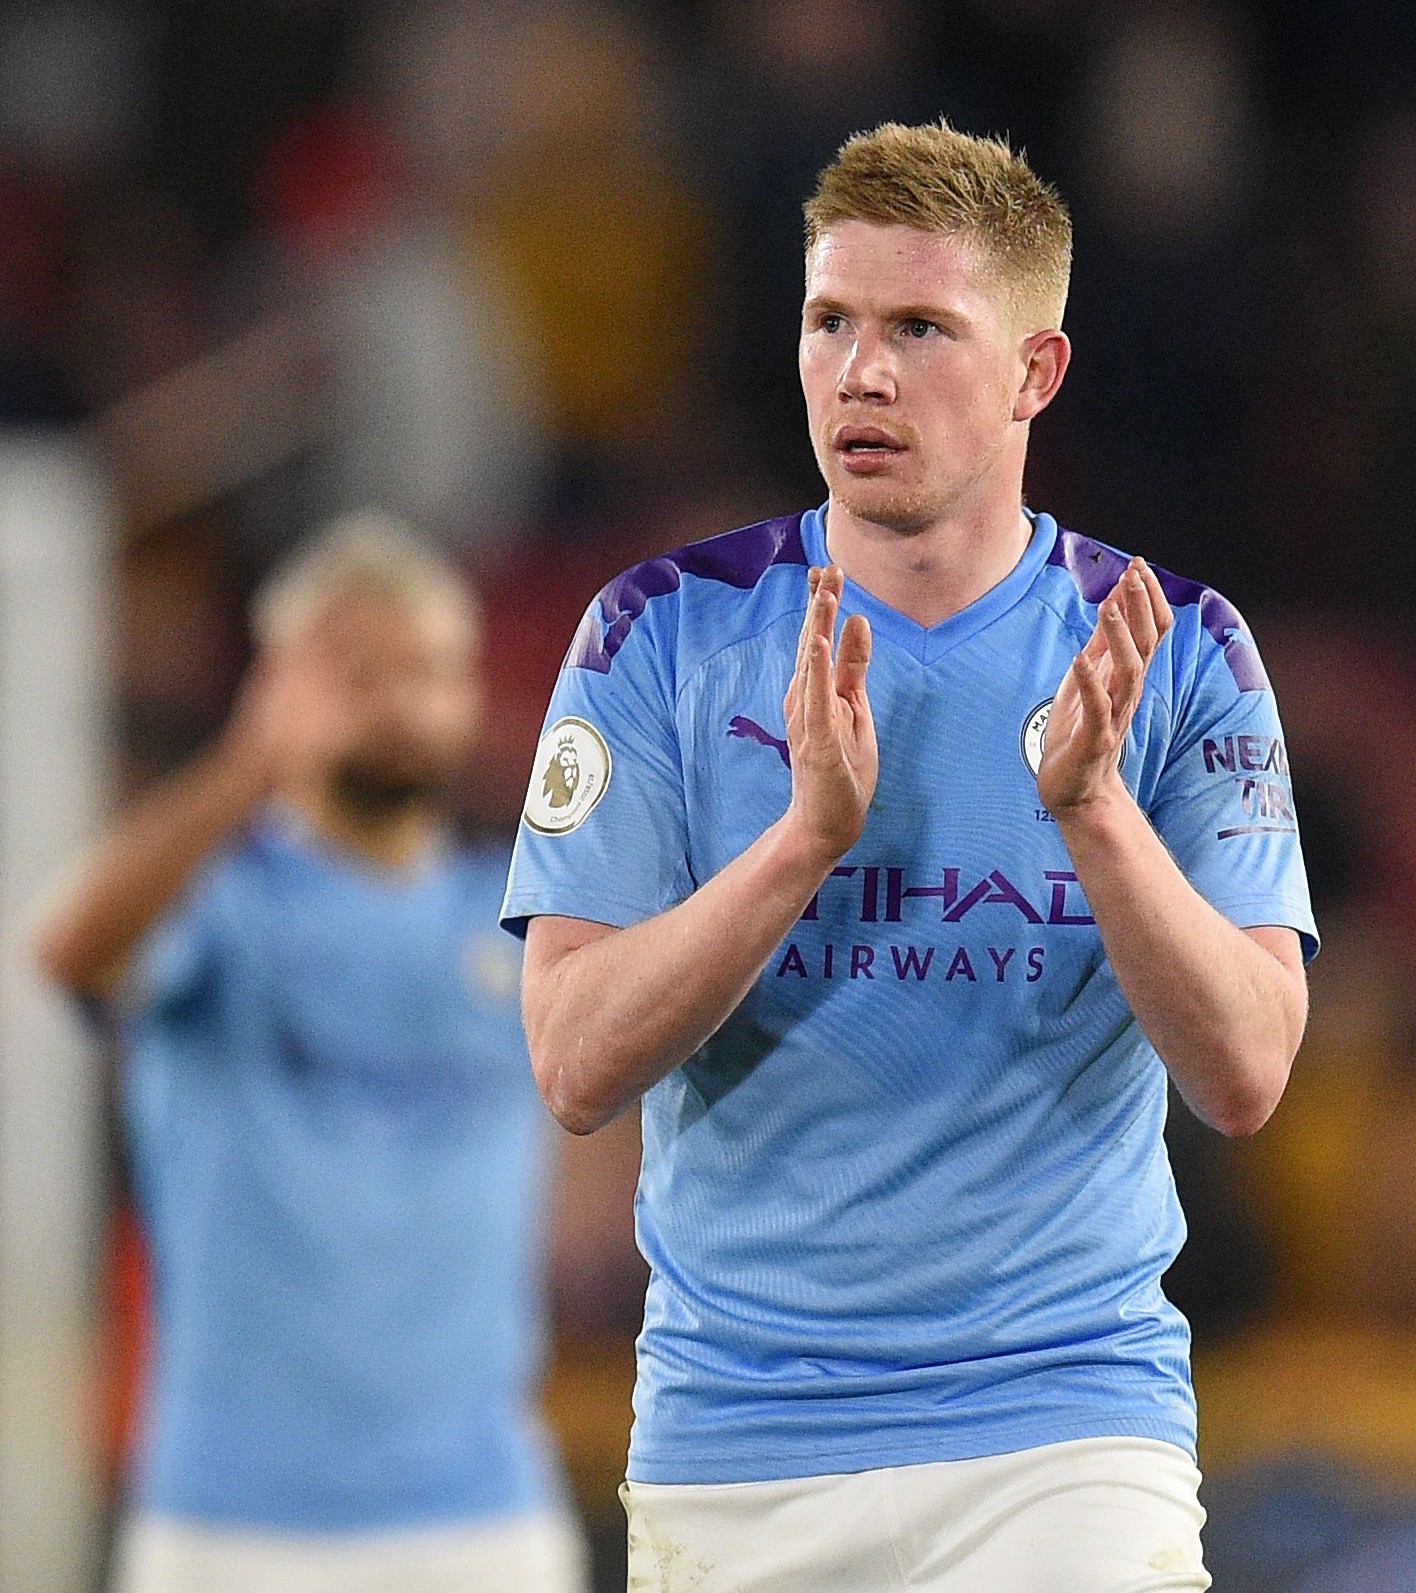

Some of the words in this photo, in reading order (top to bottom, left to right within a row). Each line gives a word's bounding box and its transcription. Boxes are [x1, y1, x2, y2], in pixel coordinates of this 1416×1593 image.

[1202, 734, 1289, 776] NEX
[1034, 808, 1056, 823] 12
[1234, 777, 1294, 821] TIR
[799, 865, 1097, 926] TIHAD
[776, 943, 1046, 983] AIRWAYS
